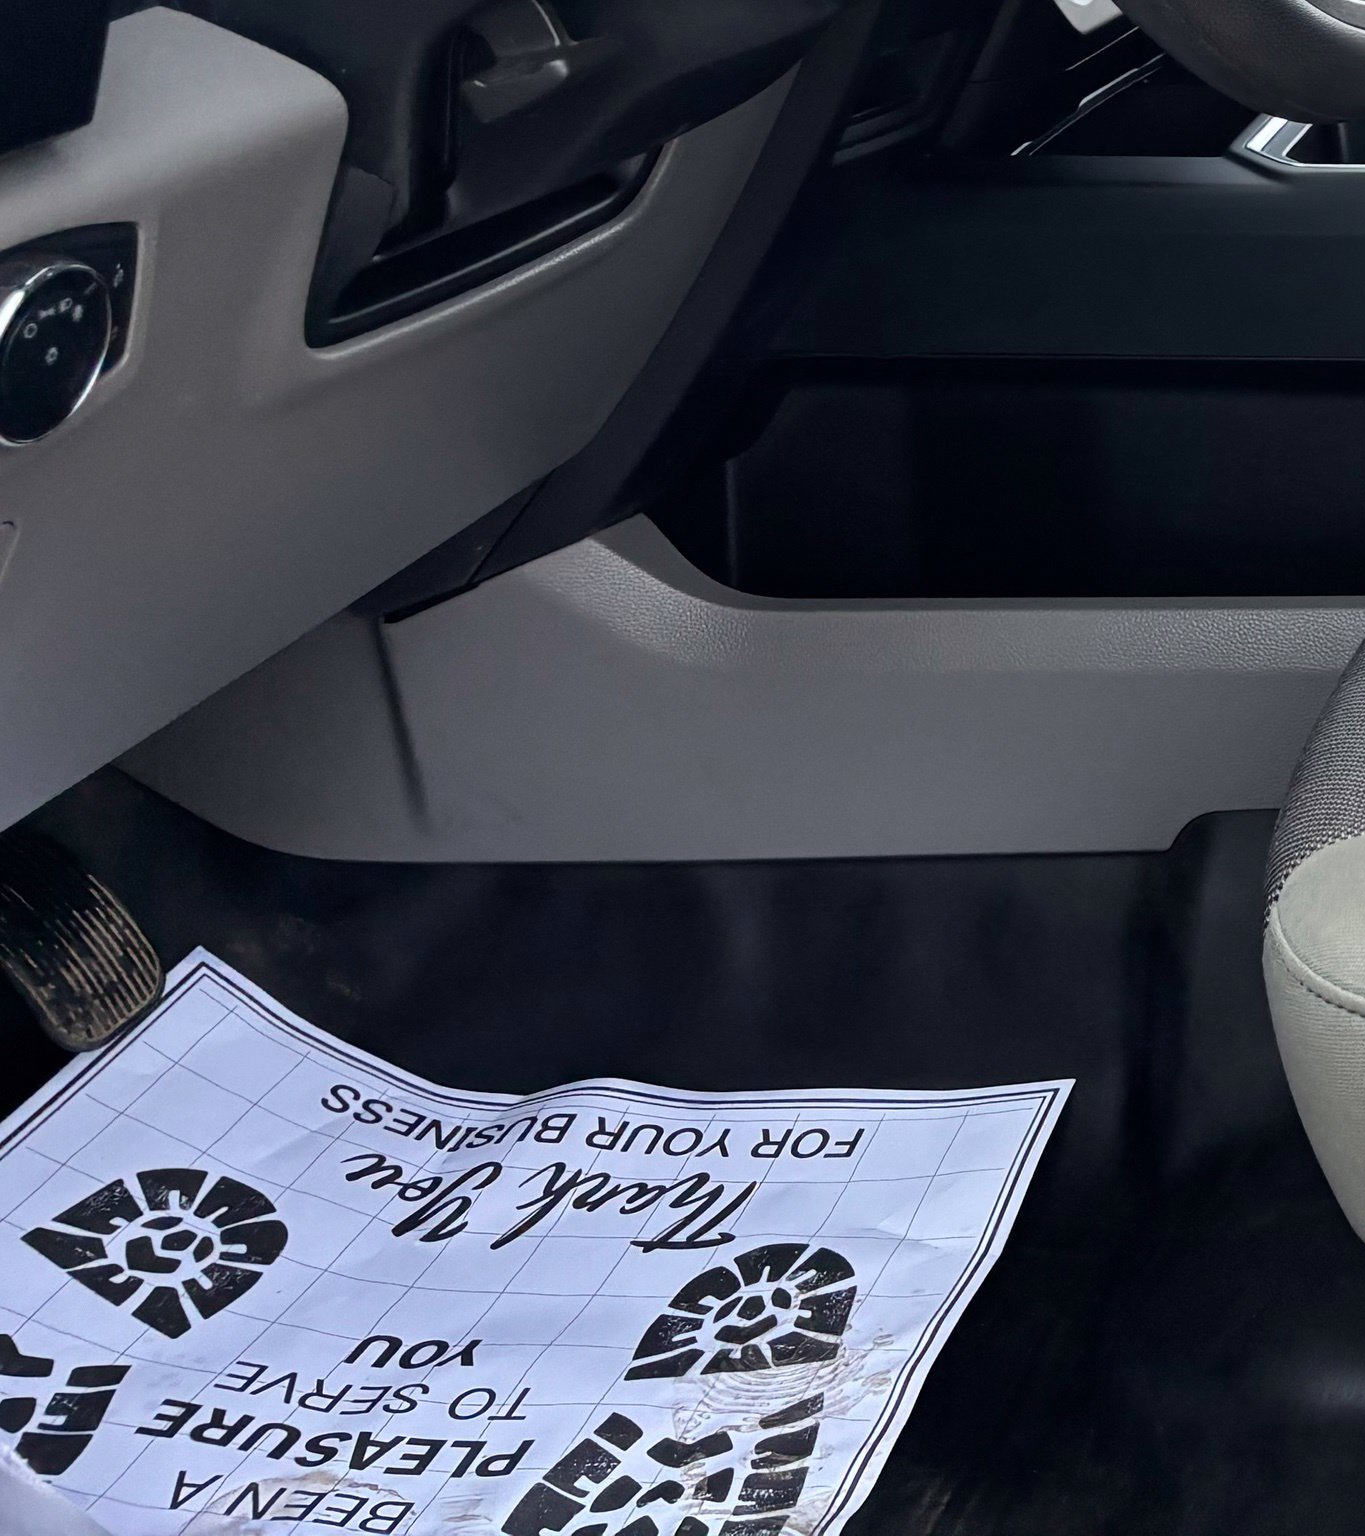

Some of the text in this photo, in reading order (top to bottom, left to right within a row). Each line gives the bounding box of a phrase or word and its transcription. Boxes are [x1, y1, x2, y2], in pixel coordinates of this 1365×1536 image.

[321, 1083, 865, 1159] FOR YOUR BUSINESS
[340, 1153, 758, 1254] Thank You
[343, 1334, 483, 1369] YOU
[213, 1360, 532, 1421] TO SERVE
[135, 1398, 535, 1479] PLEASURE
[169, 1470, 416, 1535] BEEN A
